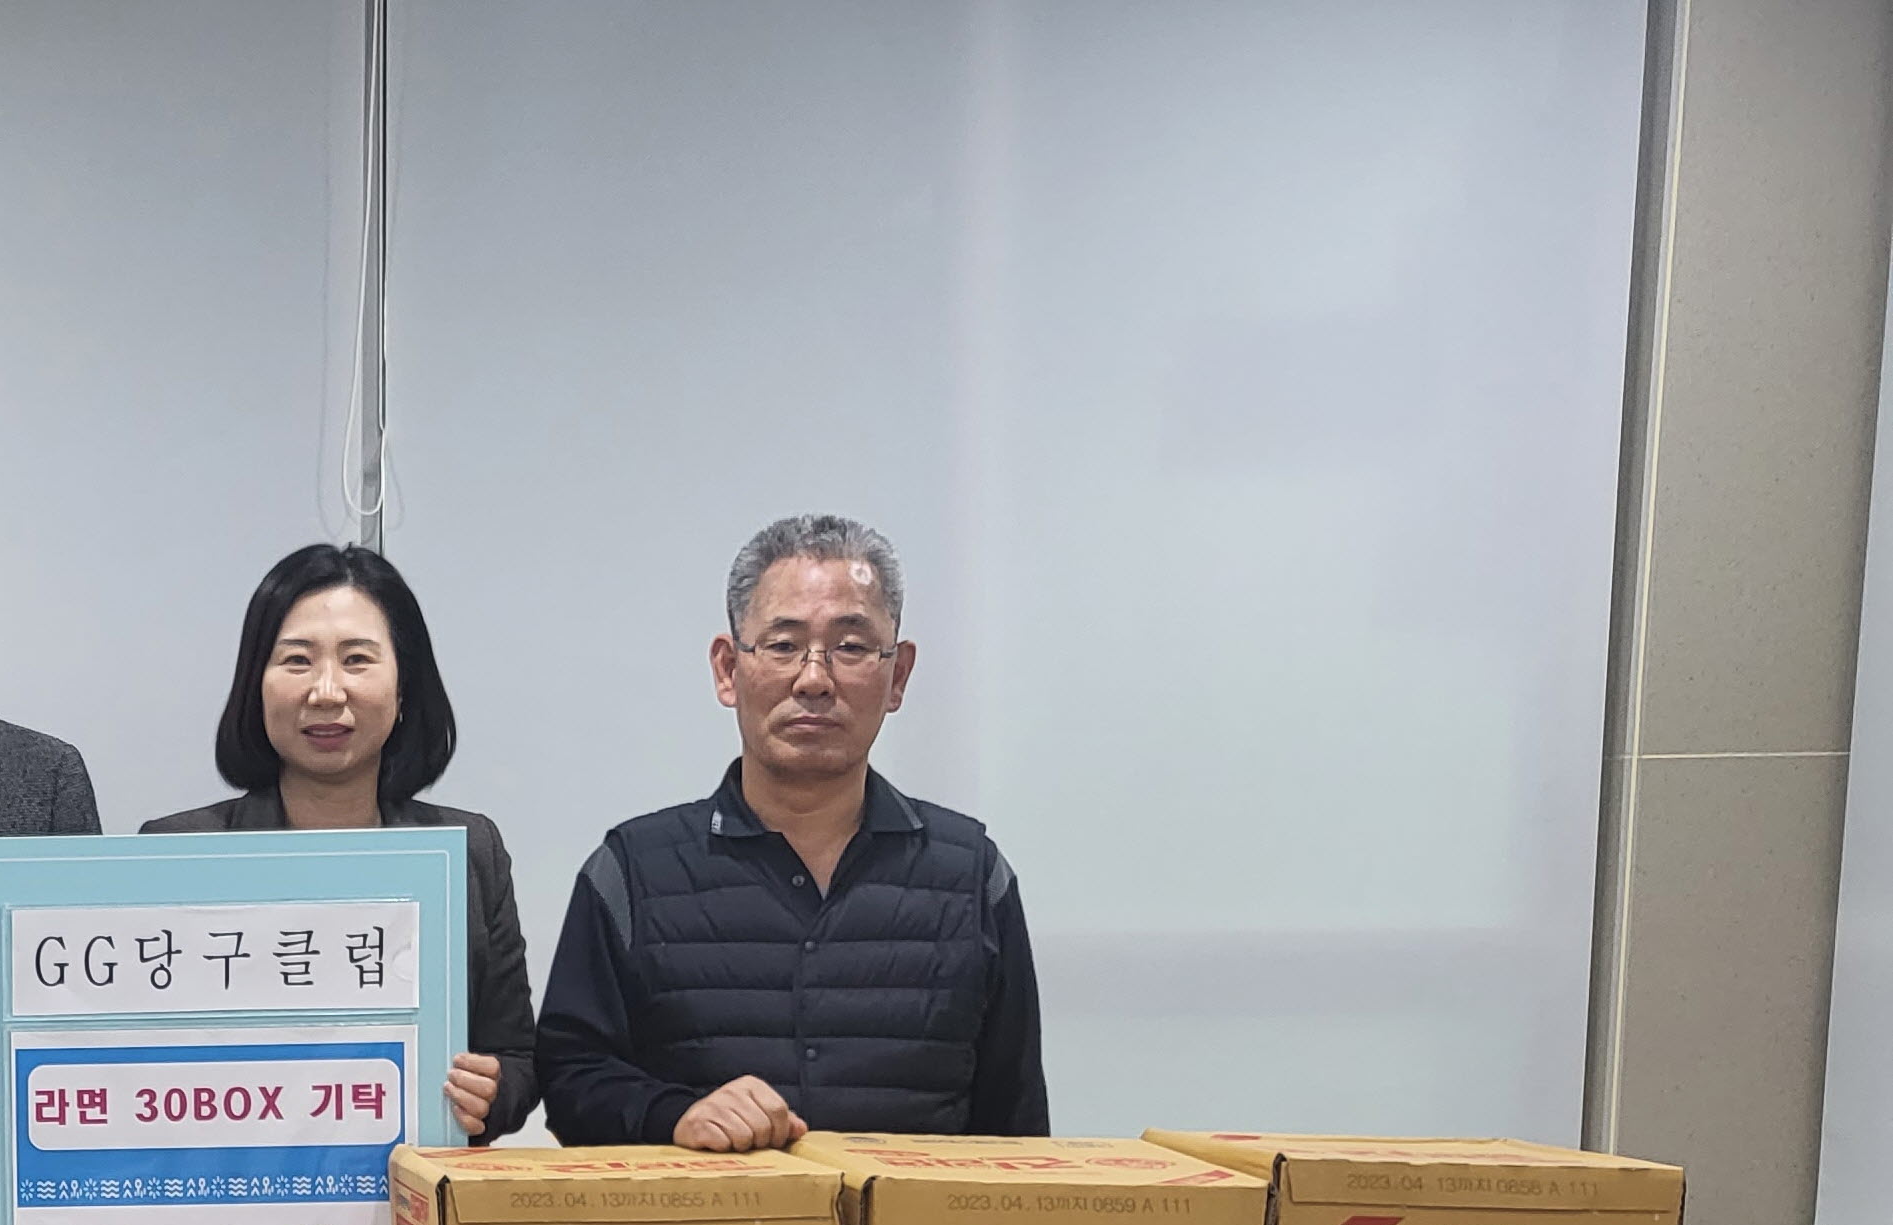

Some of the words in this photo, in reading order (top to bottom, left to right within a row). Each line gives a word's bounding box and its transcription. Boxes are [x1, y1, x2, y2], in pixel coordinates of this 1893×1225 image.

[34, 926, 385, 990] GG당구클럽
[34, 1087, 108, 1126] 라면
[135, 1085, 285, 1122] 30BOX
[309, 1083, 387, 1121] 기탁
